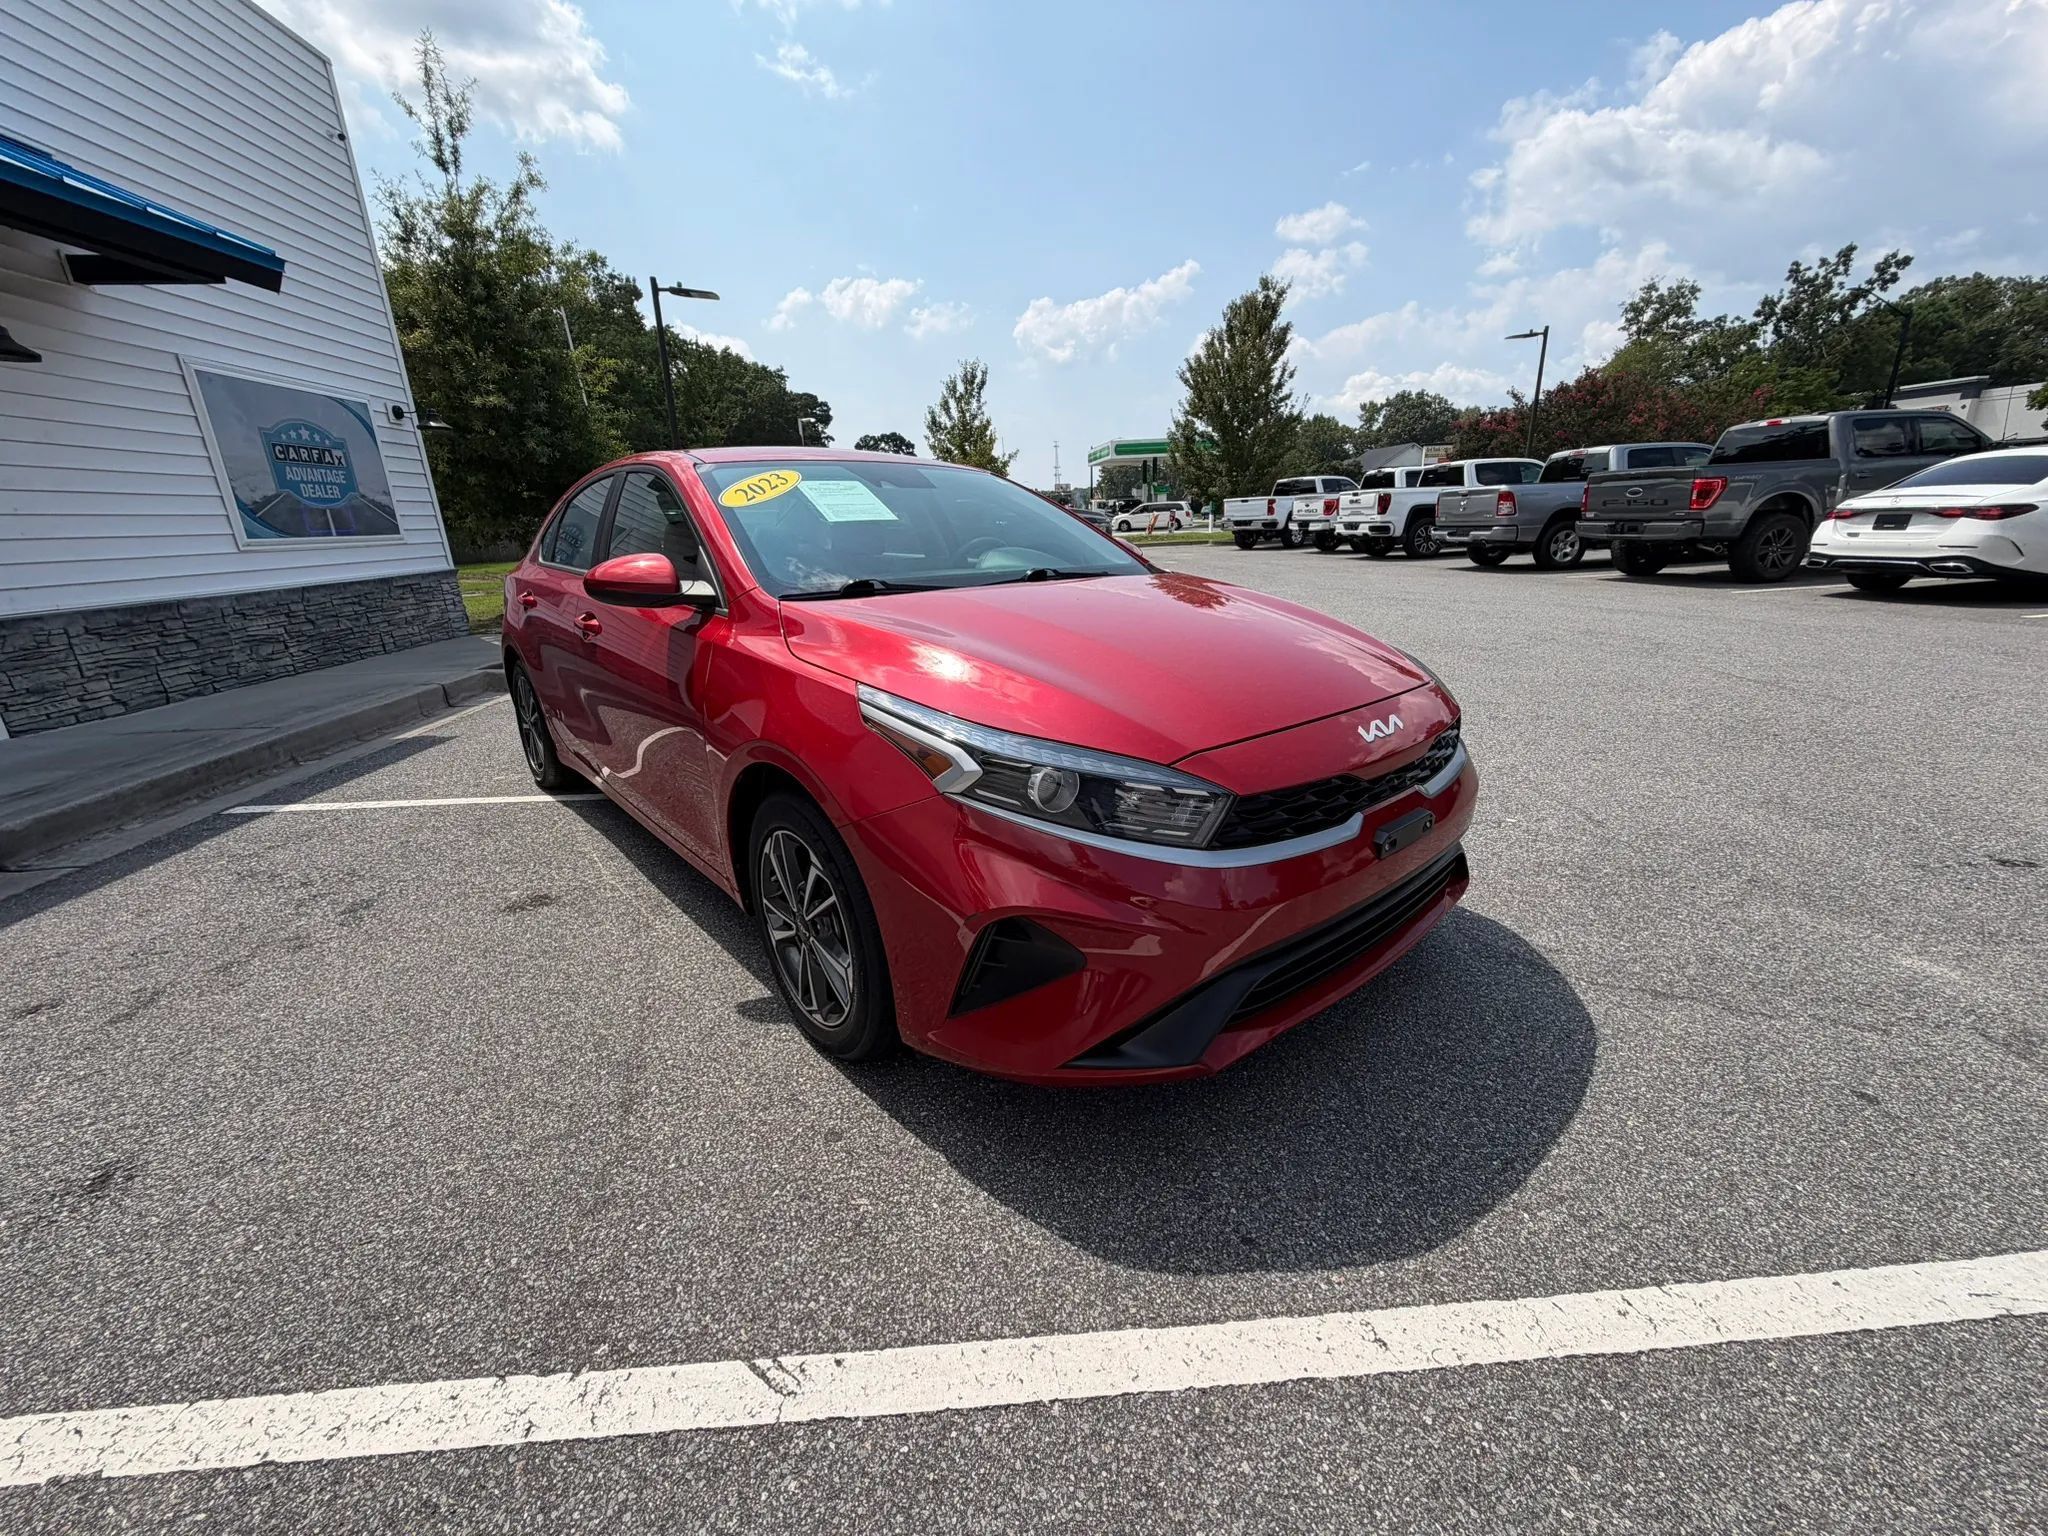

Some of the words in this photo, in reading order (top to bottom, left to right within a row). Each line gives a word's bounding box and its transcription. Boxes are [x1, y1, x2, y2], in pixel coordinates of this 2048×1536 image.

[274, 443, 345, 467] CARFAX
[285, 466, 346, 484] ADVANTAGE
[300, 483, 341, 499] DEALER
[734, 473, 788, 502] 2023
[1358, 714, 1404, 743] KIA
